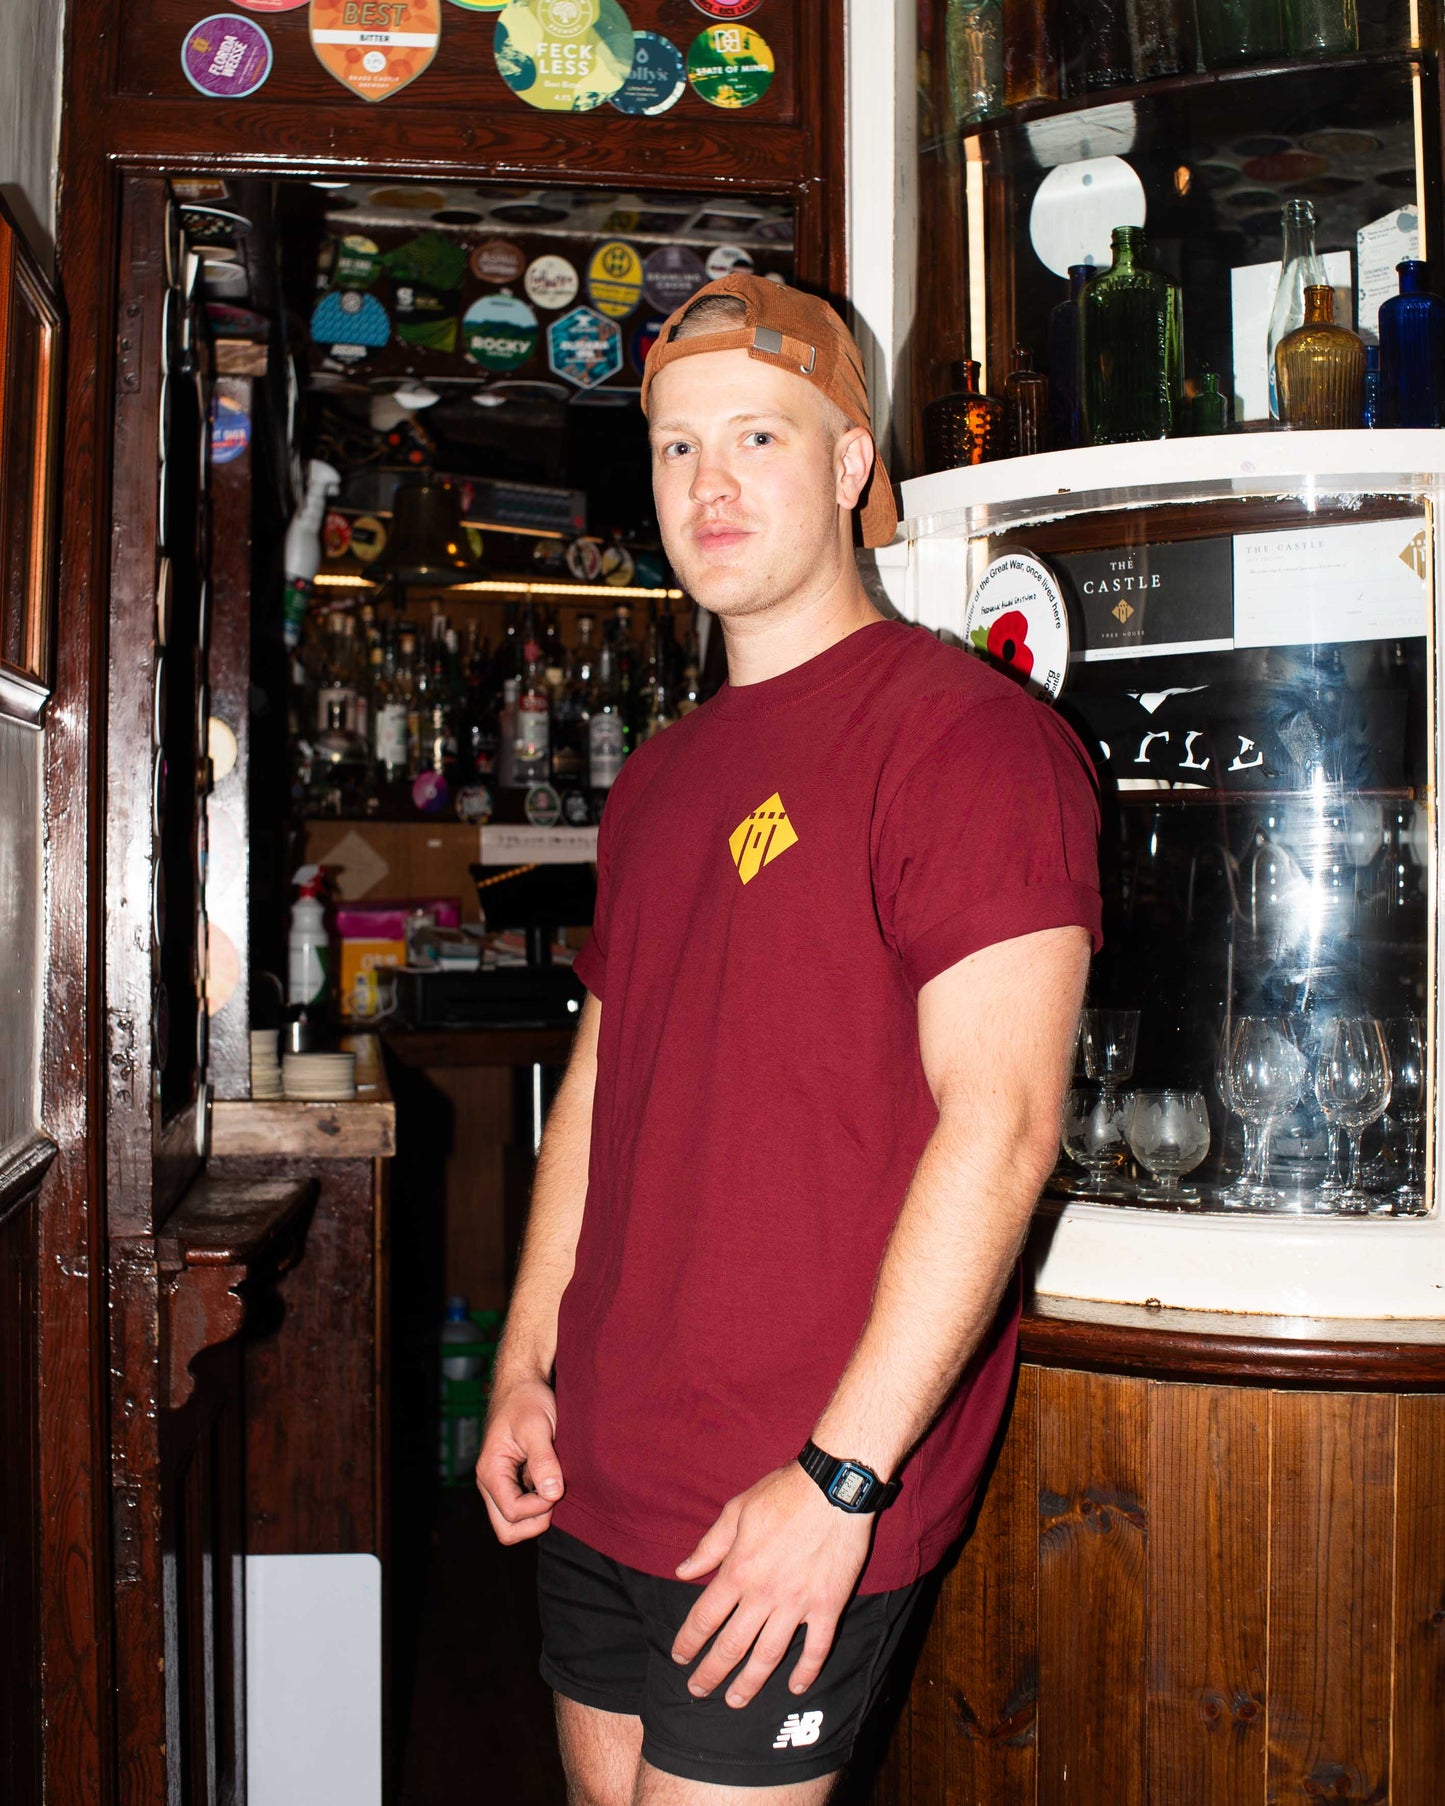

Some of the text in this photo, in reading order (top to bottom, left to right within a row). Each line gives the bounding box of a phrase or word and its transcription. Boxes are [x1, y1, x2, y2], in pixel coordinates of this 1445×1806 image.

[342, 2, 408, 27] BEST
[360, 34, 390, 42] BITTER
[536, 42, 593, 59] FECK
[540, 60, 589, 76] LESS
[627, 67, 668, 84] olly's
[695, 64, 768, 76] STATE OF MIND
[471, 336, 531, 353] ROCKY
[1245, 540, 1325, 554] THE CASTLE
[1110, 560, 1134, 571] THE
[1083, 574, 1161, 594] CASTLE
[974, 590, 981, 602] of
[979, 577, 990, 591] the
[990, 560, 1009, 578] Great
[1010, 559, 1025, 573] War,
[1026, 565, 1042, 582] once
[1041, 578, 1056, 602] lived
[1052, 601, 1061, 630] here
